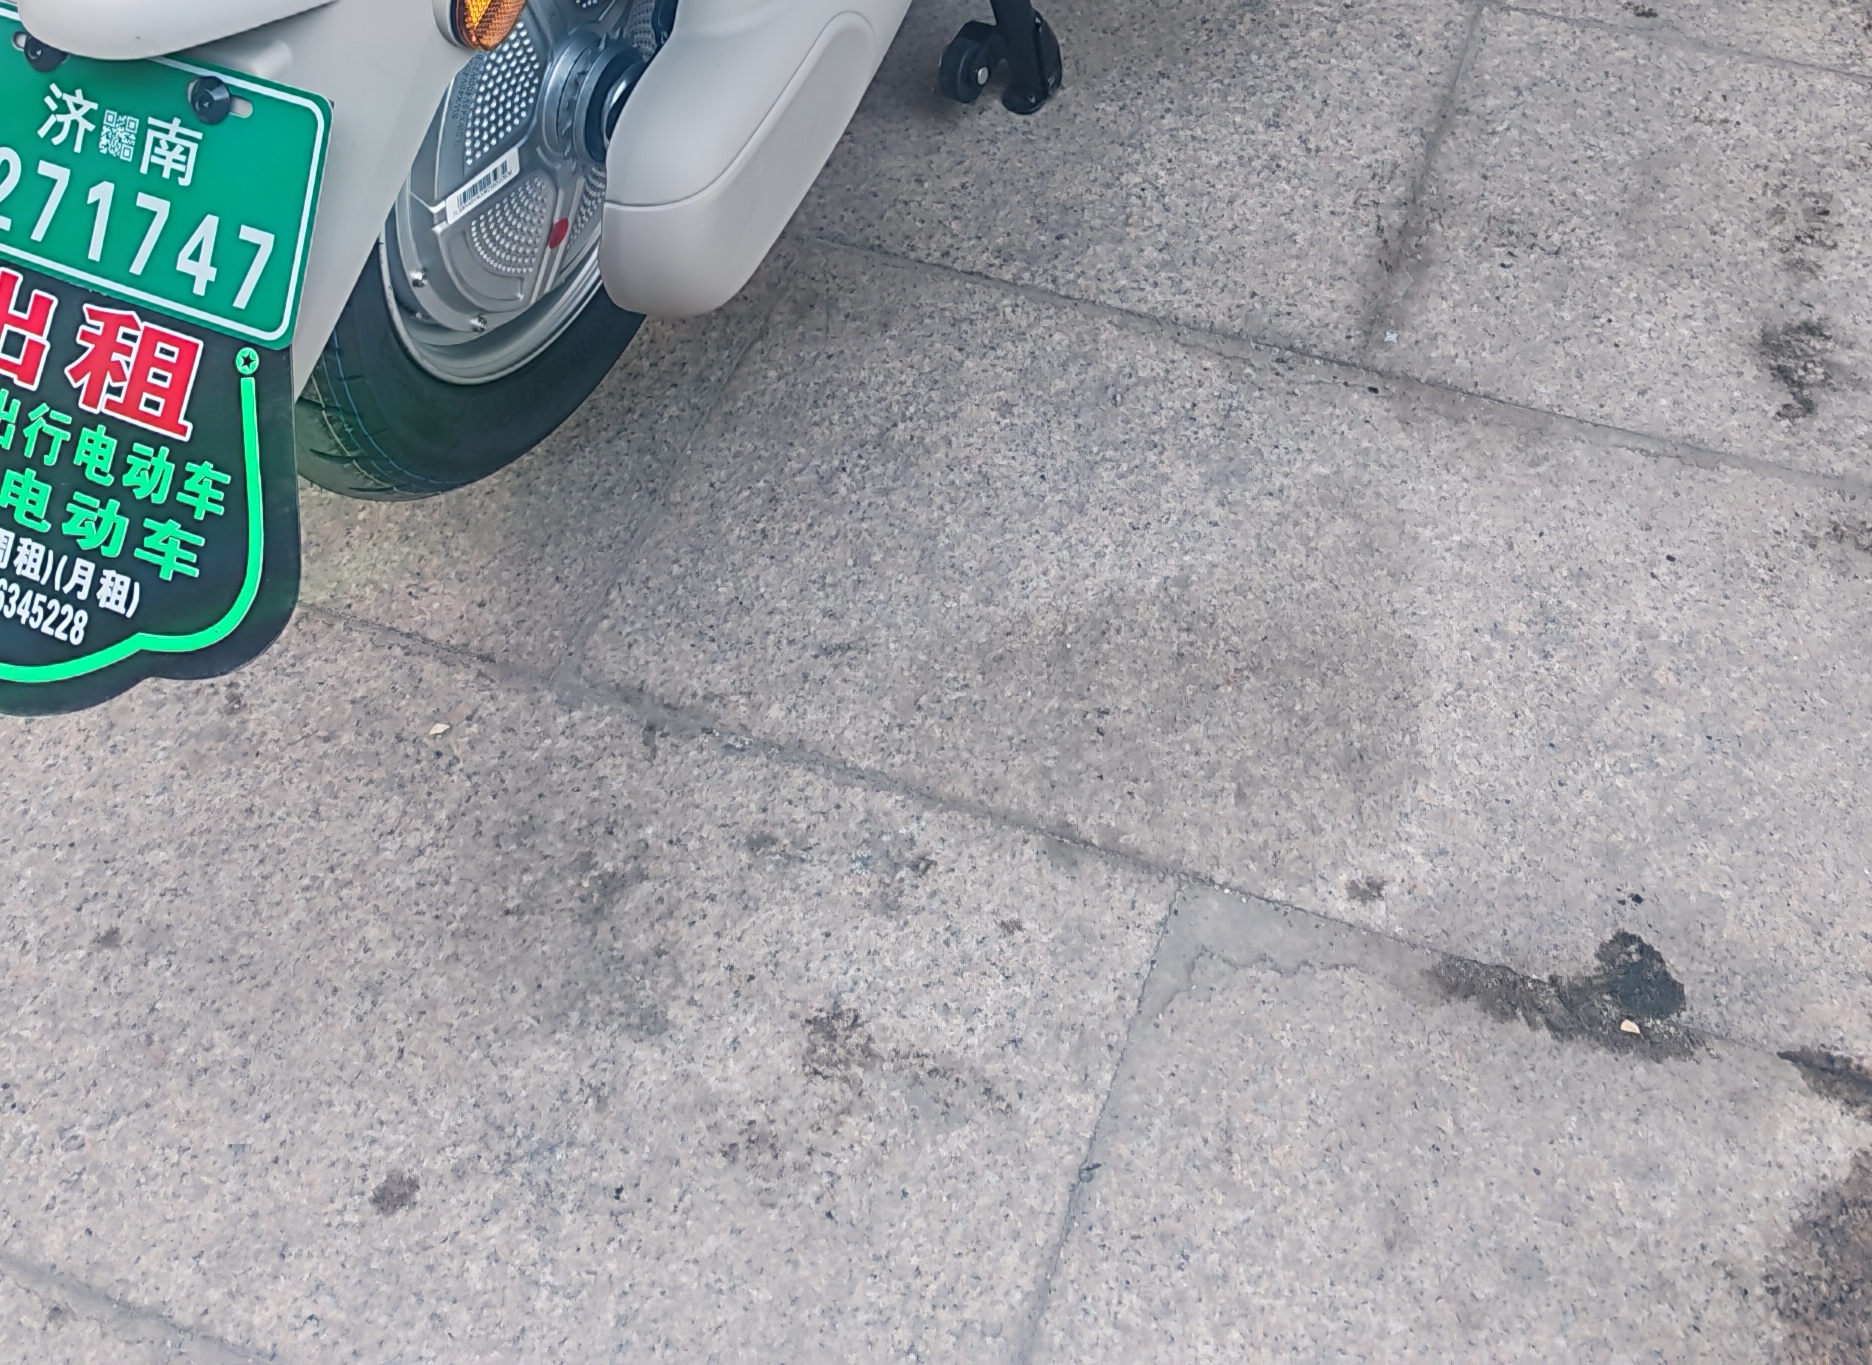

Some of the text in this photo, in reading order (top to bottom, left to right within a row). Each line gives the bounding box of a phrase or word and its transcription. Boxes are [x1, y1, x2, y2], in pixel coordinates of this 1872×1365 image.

[37, 82, 203, 187] 济南
[0, 146, 275, 310] 271747
[0, 468, 205, 581] 电动车
